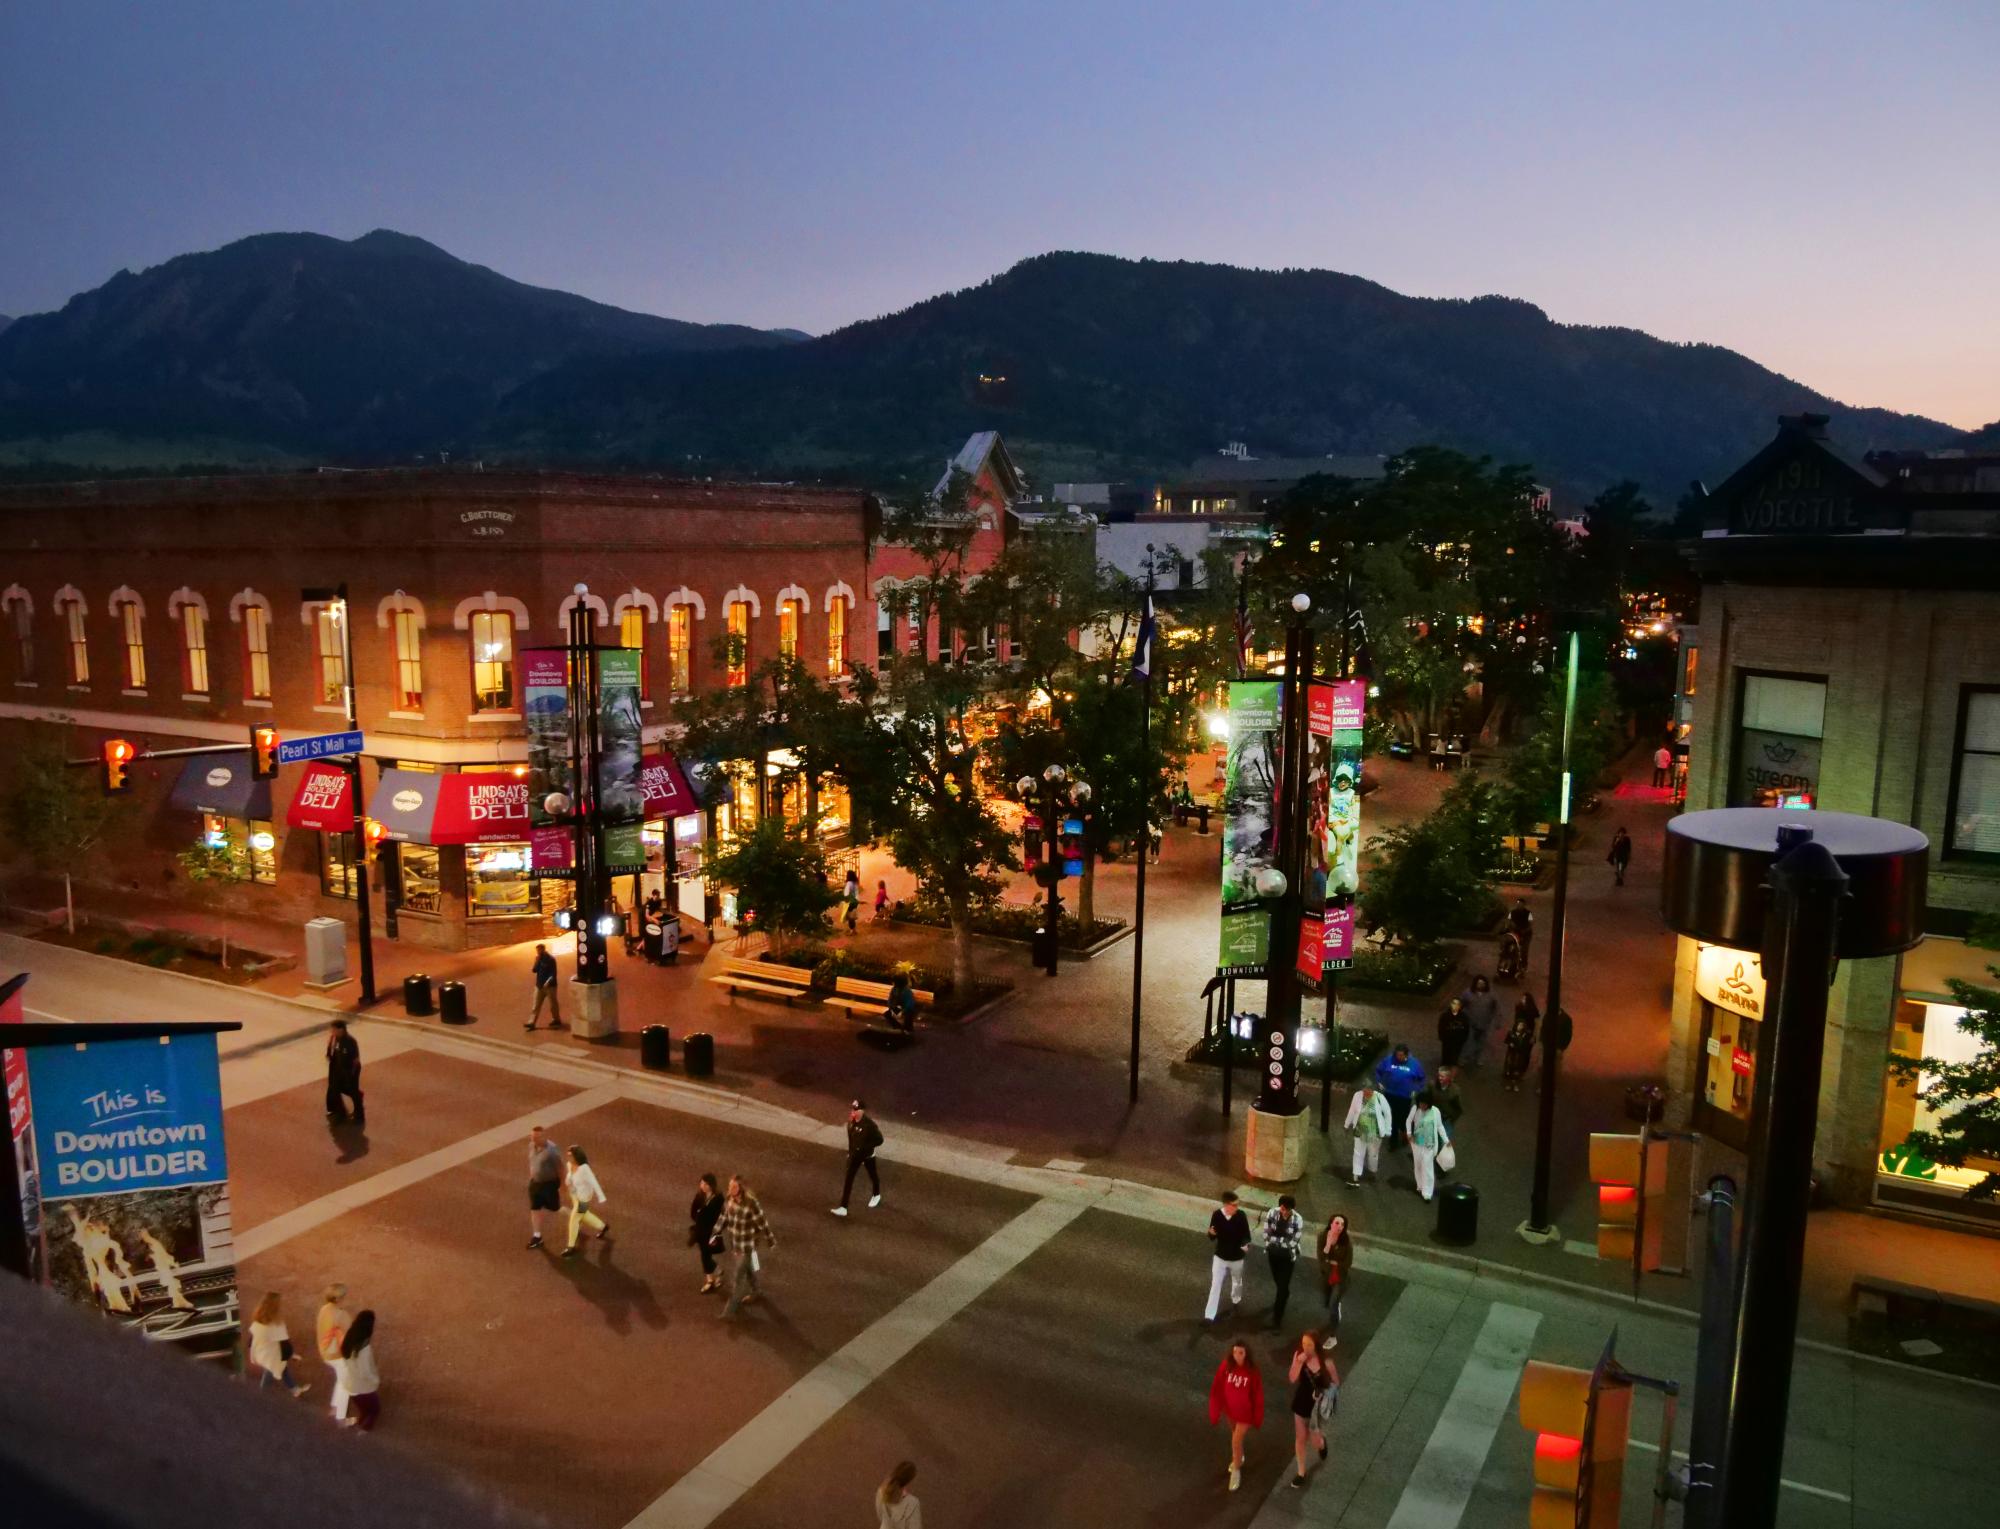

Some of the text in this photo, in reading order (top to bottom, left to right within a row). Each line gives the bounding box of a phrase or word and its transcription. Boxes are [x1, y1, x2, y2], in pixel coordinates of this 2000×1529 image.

[1233, 709, 1272, 717] Downtown
[1333, 708, 1360, 717] ntown
[1234, 718, 1272, 727] BOULDER
[281, 743, 308, 759] Pearl
[311, 740, 322, 755] St
[325, 737, 345, 752] Mall
[307, 773, 347, 789] LINDSAY'S
[1747, 766, 1809, 793] stream
[305, 784, 341, 795] BOULDER
[469, 784, 529, 799] LINDSAY'S
[301, 792, 340, 809] DELI
[469, 797, 529, 806] BOULDER
[469, 804, 529, 821] DELI
[478, 833, 520, 841] sandwiches
[534, 868, 571, 877] DOWNTOWN
[1222, 966, 1265, 976] DOWNTOWN
[1321, 960, 1346, 969] ULDER
[82, 1084, 167, 1117] This is
[54, 1124, 206, 1154] Downtown
[58, 1150, 208, 1185] BOULDER
